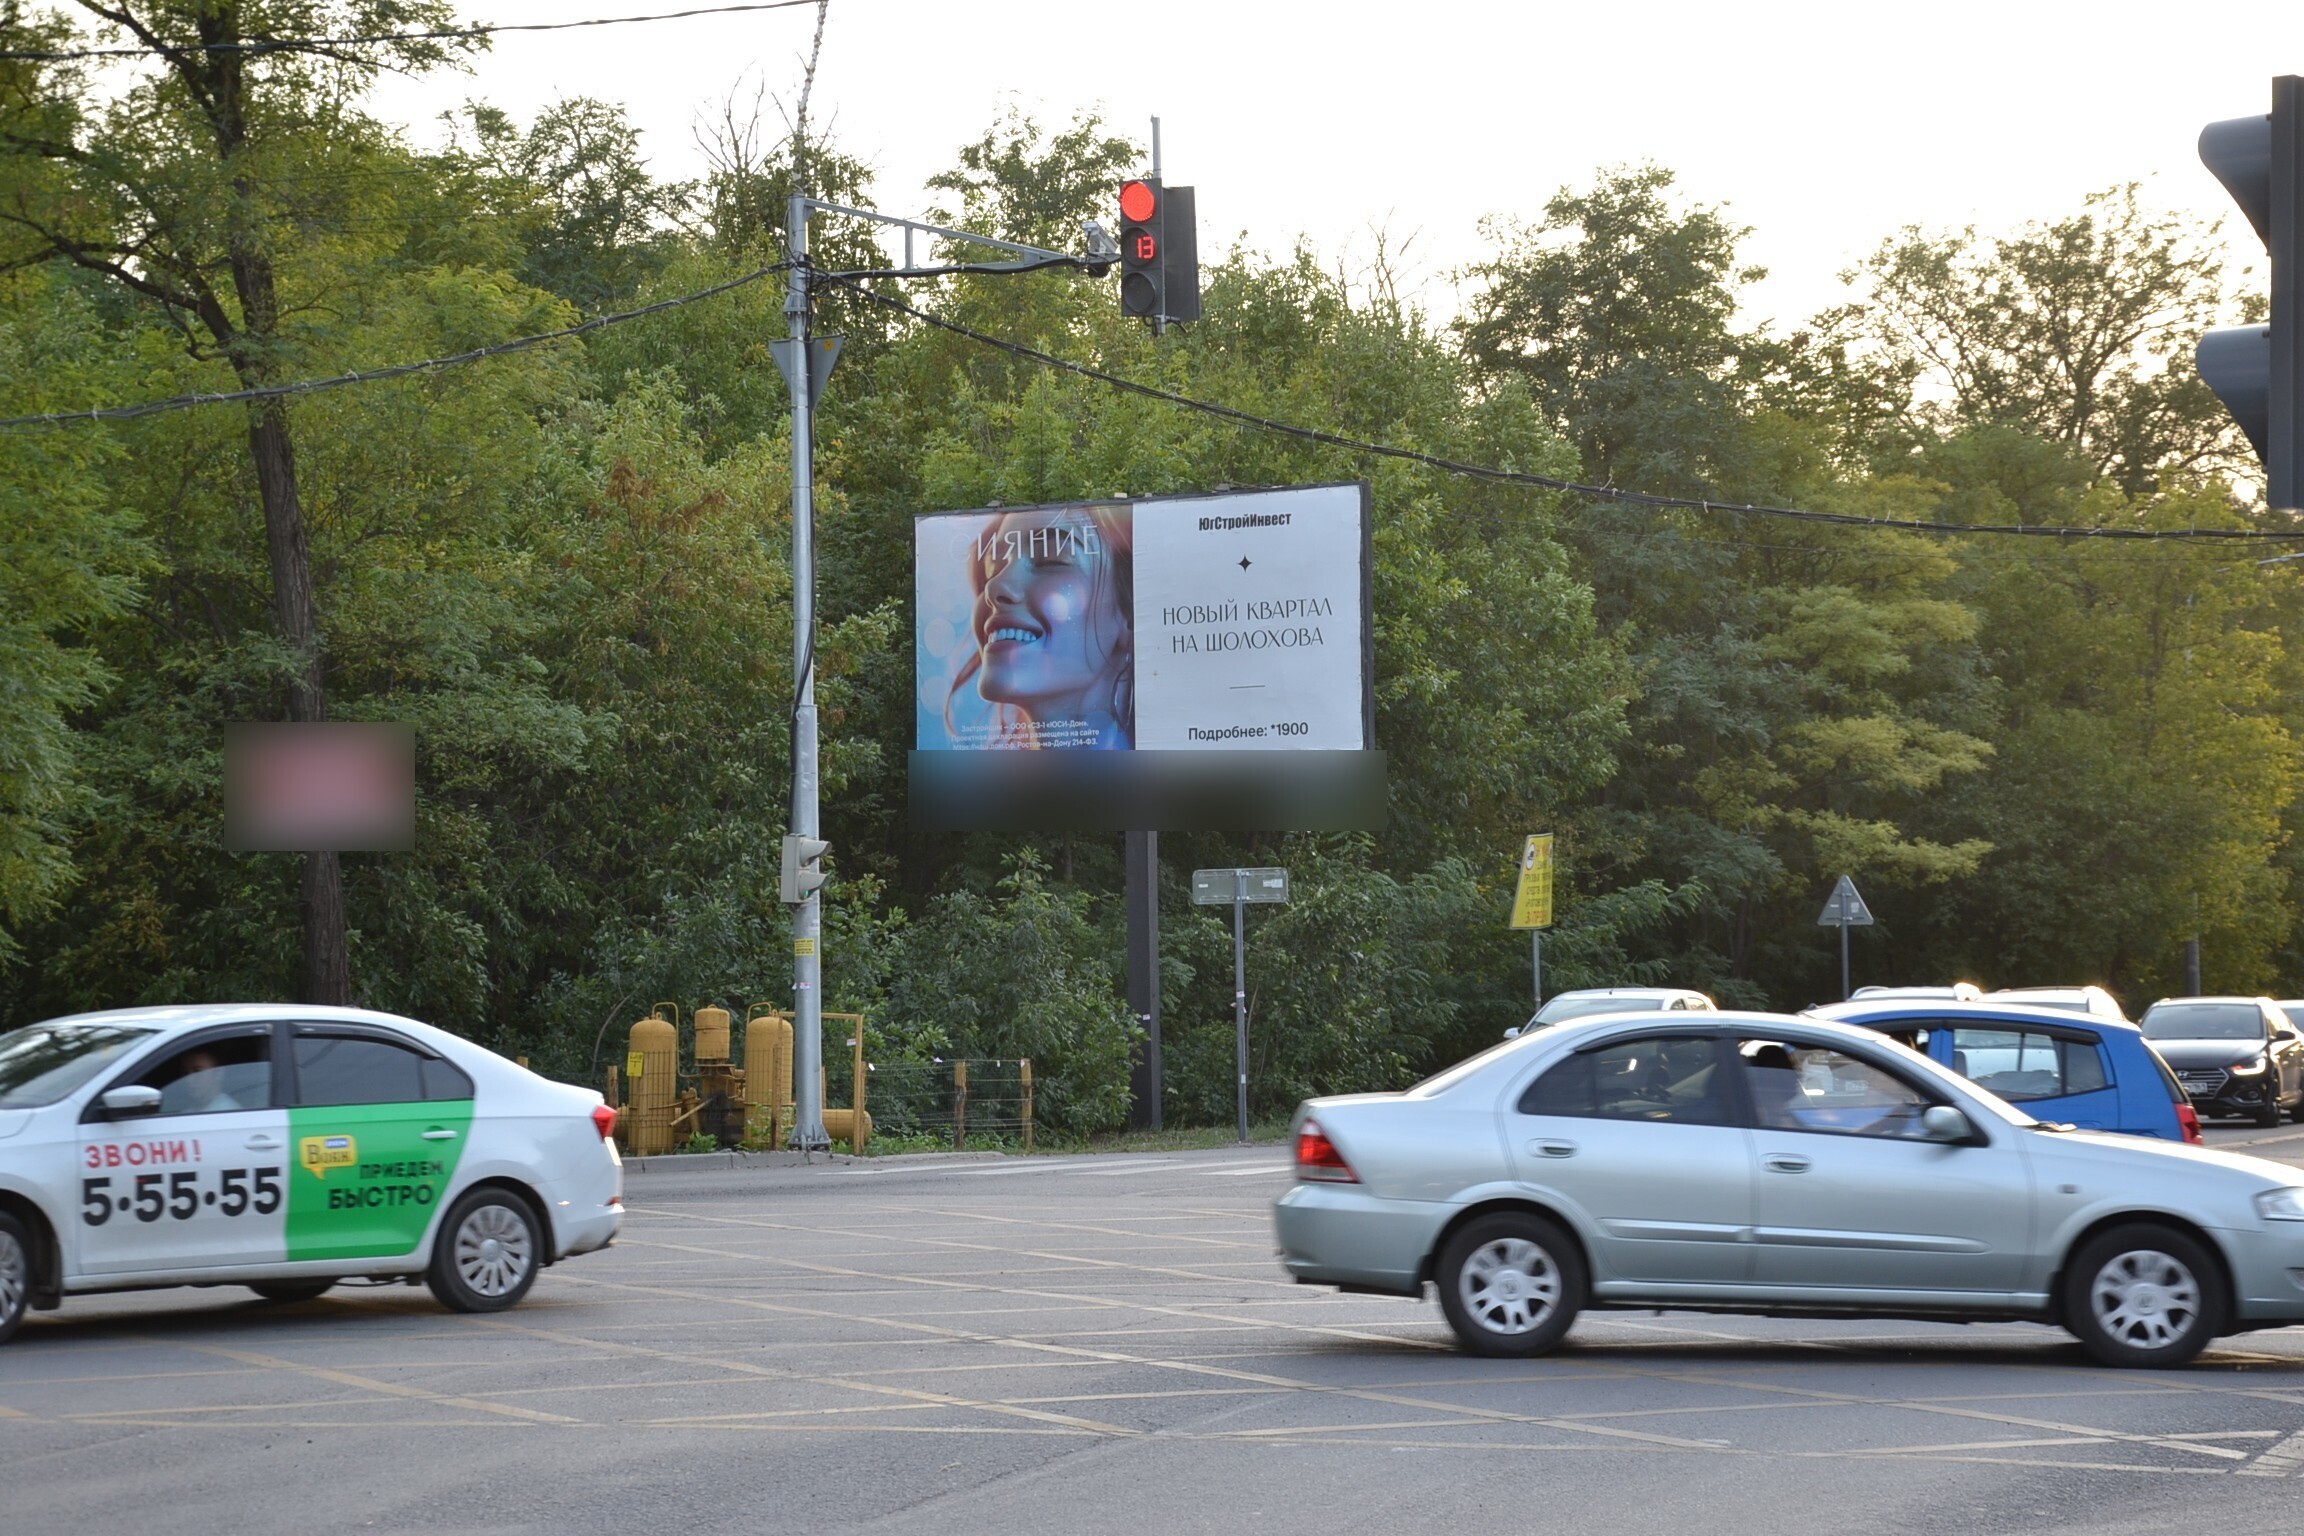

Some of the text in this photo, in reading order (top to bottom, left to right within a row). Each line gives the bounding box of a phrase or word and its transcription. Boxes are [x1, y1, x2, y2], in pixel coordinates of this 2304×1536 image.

[1137, 236, 1155, 259] 13
[1198, 513, 1292, 531] ЮгСтройИнвест
[1163, 597, 1333, 625] НОВЫЙ КВАРТАЛ
[1172, 627, 1324, 654] НА ШОЛОХОВА
[1188, 726, 1268, 742] Подробнее:
[84, 1139, 203, 1169] ЗВОНИ!
[359, 1160, 444, 1180] ПРИЕДЕМ
[327, 1184, 435, 1210] БЫСТРО
